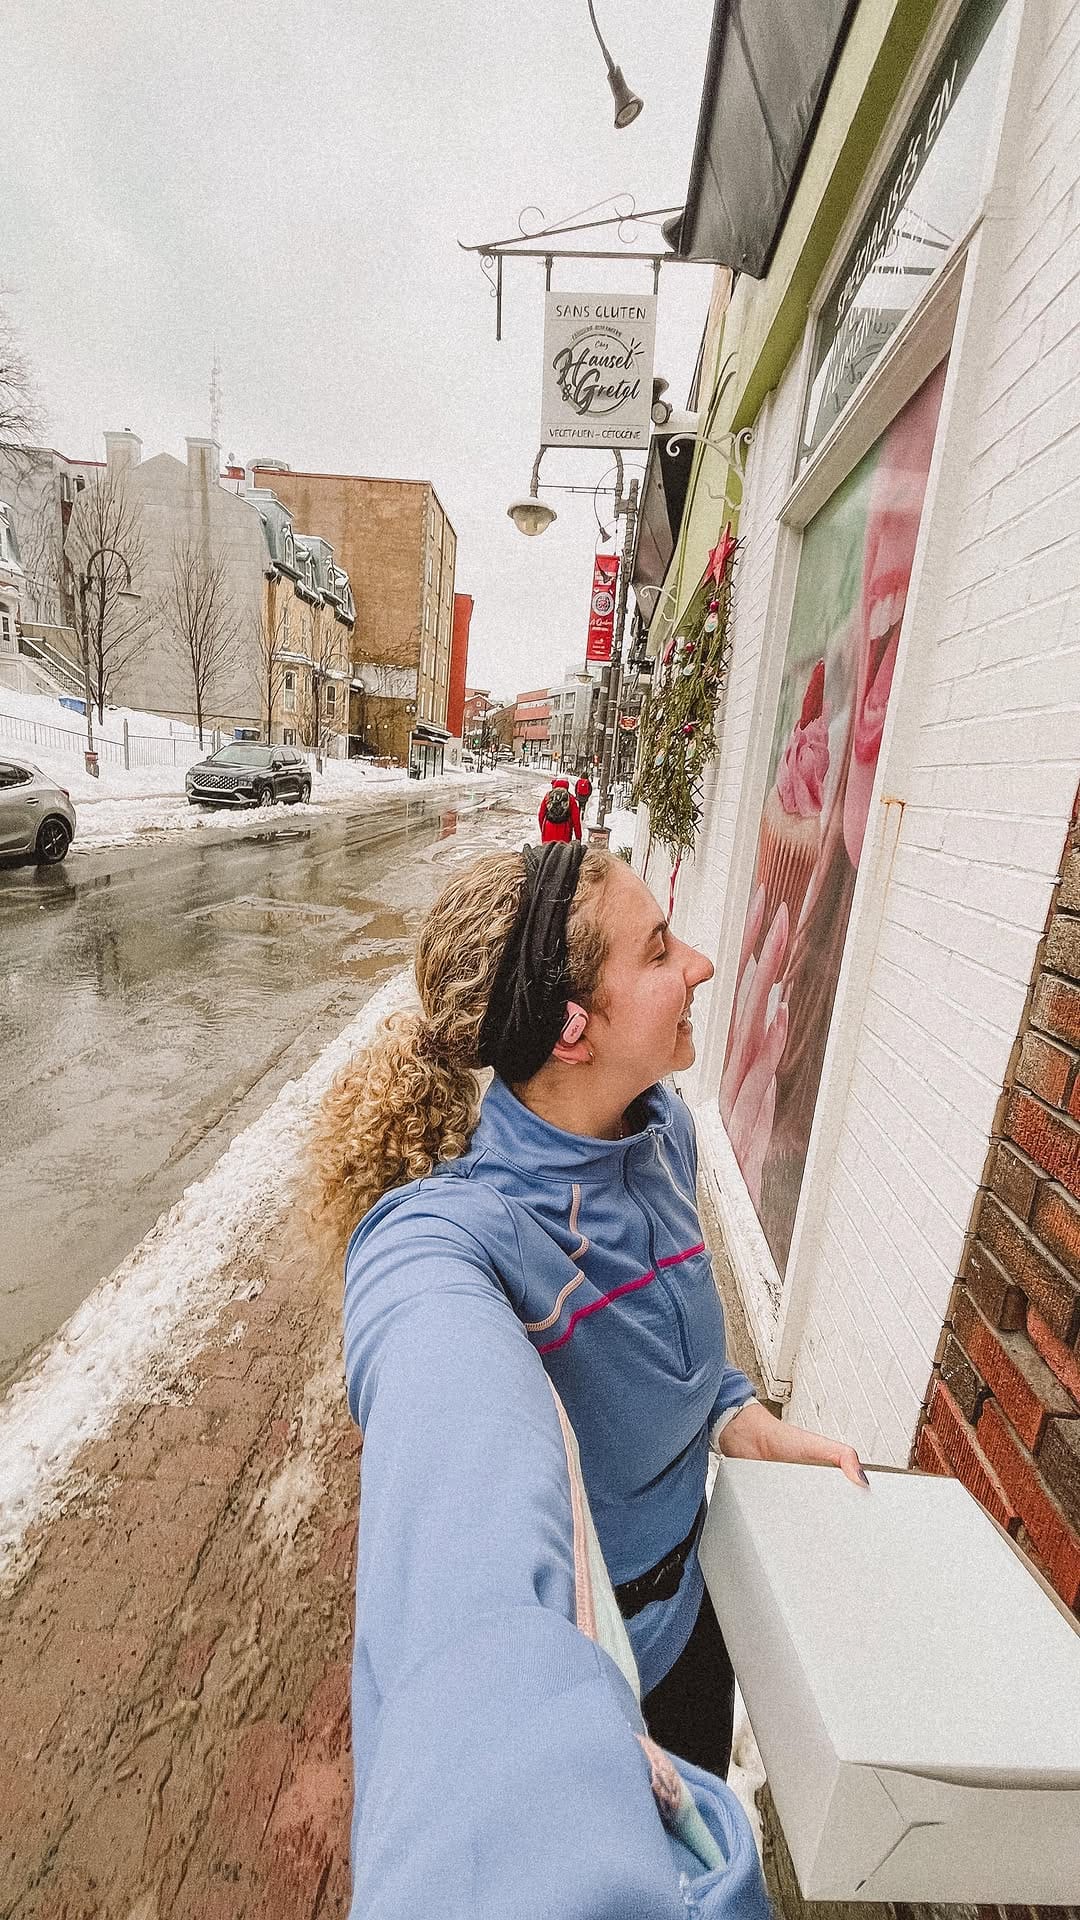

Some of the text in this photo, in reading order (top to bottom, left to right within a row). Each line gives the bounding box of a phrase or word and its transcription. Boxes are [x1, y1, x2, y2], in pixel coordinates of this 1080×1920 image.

[924, 59, 957, 151] EN
[556, 304, 646, 320] SANS GLUTEN
[552, 347, 634, 386] Hansel
[573, 368, 641, 416] Gretel
